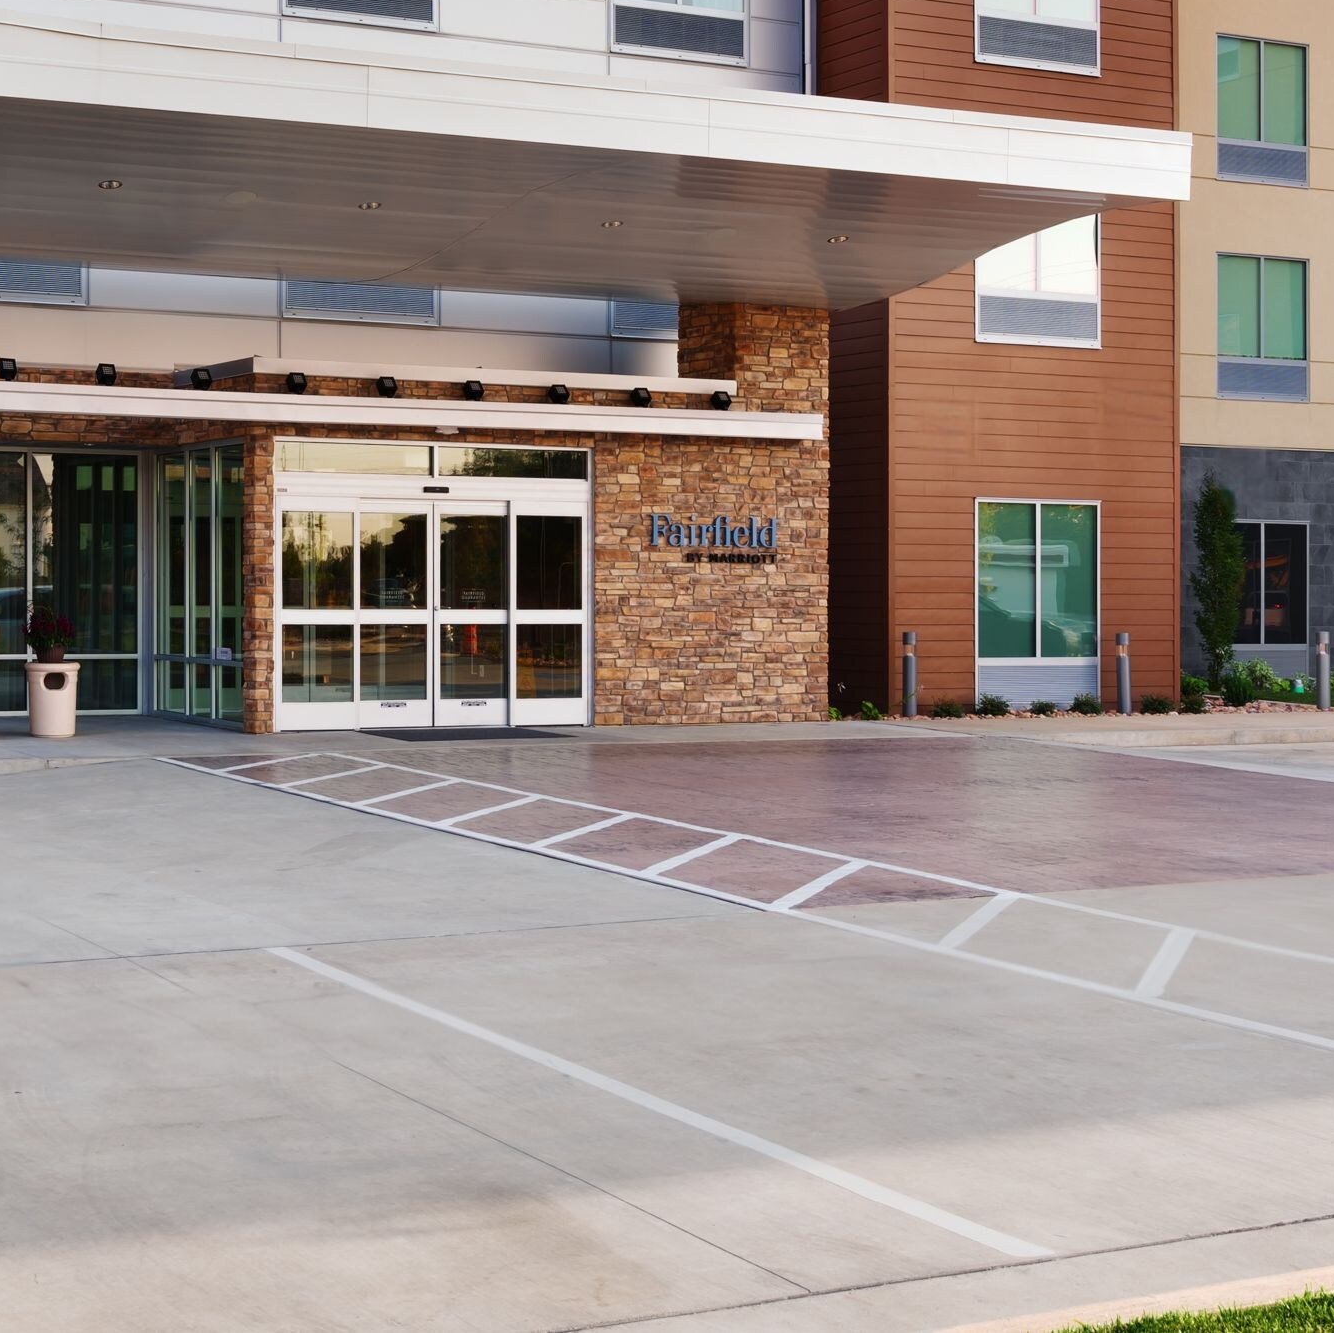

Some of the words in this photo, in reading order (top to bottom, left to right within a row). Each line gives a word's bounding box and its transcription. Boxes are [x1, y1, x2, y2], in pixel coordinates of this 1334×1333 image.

[650, 513, 778, 549] Fairfield
[685, 552, 702, 564] BY
[708, 553, 778, 565] MARRIOTT
